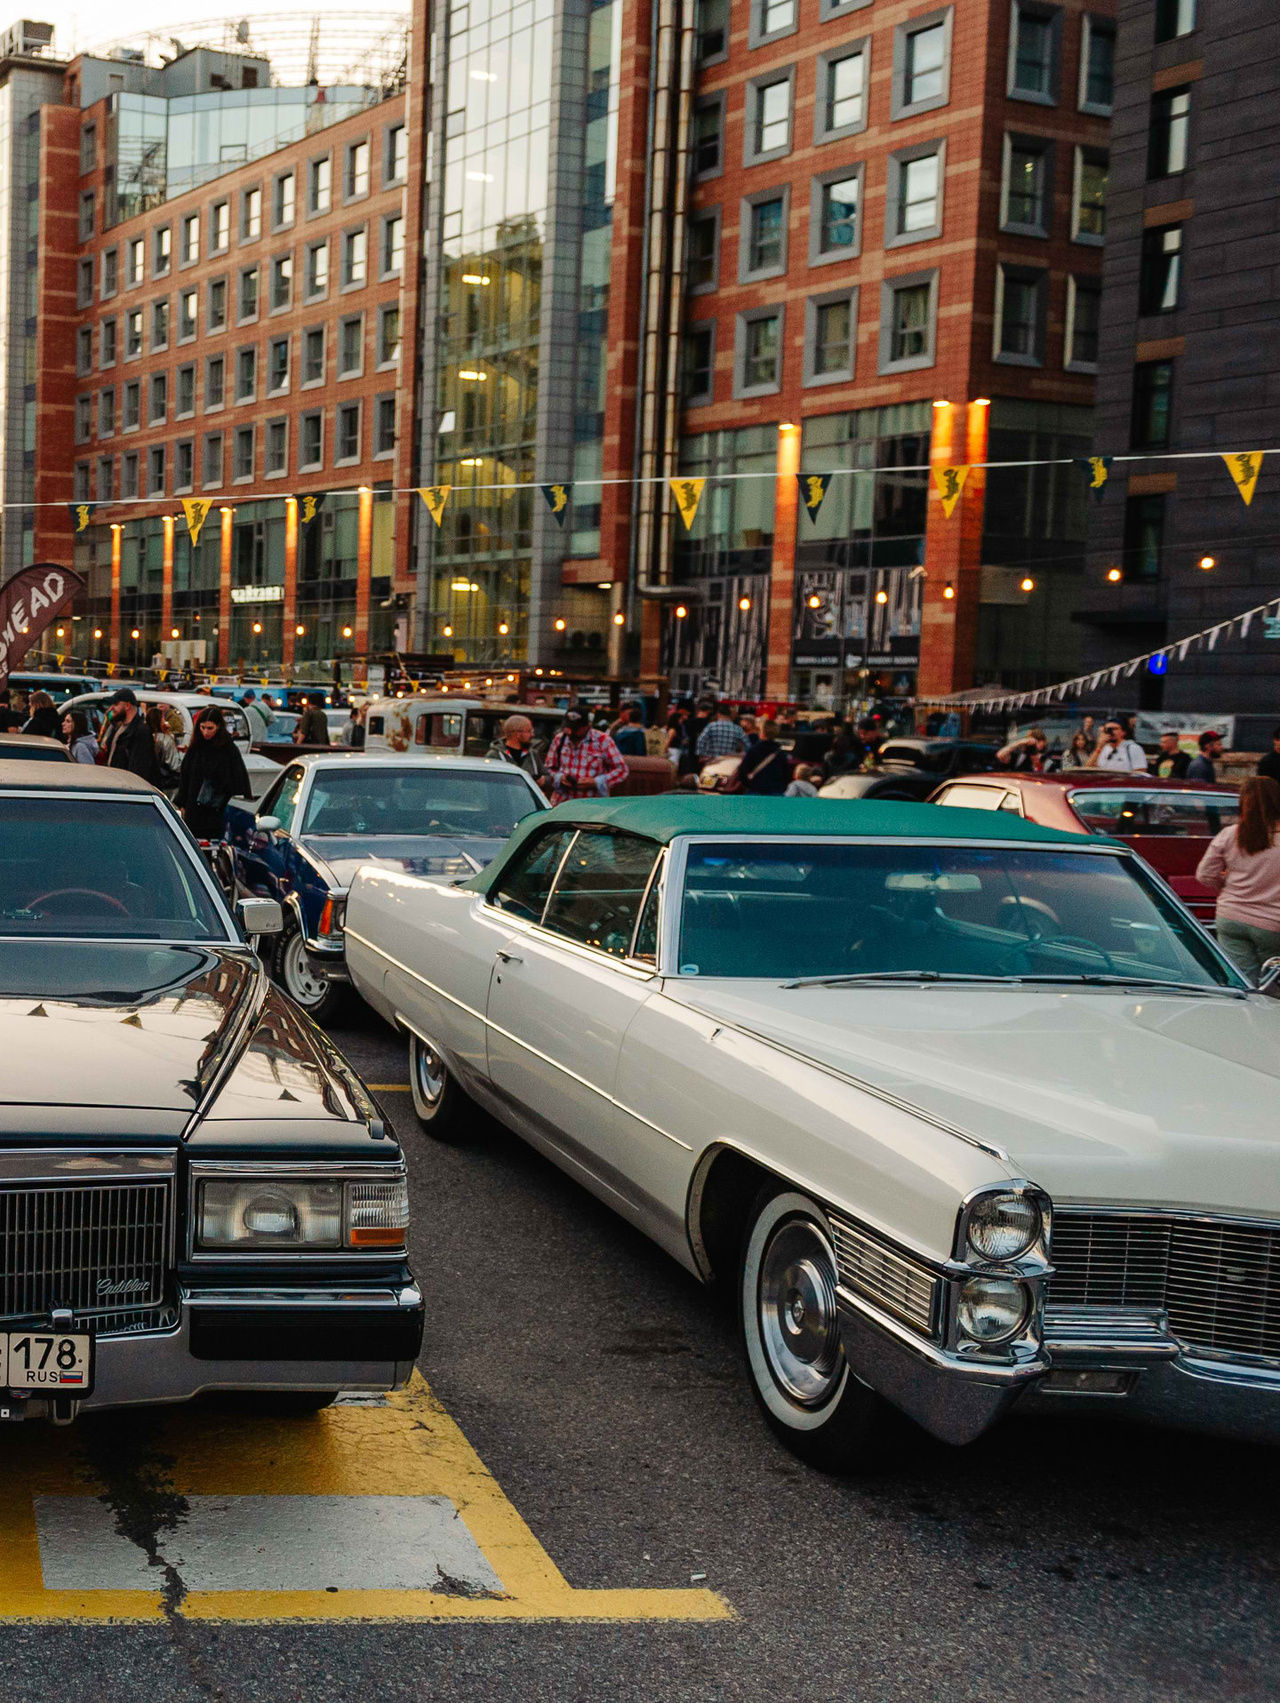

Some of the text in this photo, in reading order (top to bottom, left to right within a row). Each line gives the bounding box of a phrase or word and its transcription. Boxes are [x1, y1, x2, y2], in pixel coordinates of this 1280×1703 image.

[96, 1278, 150, 1296] Cadillac
[13, 1337, 77, 1370] 178
[26, 1371, 58, 1383] RUS
